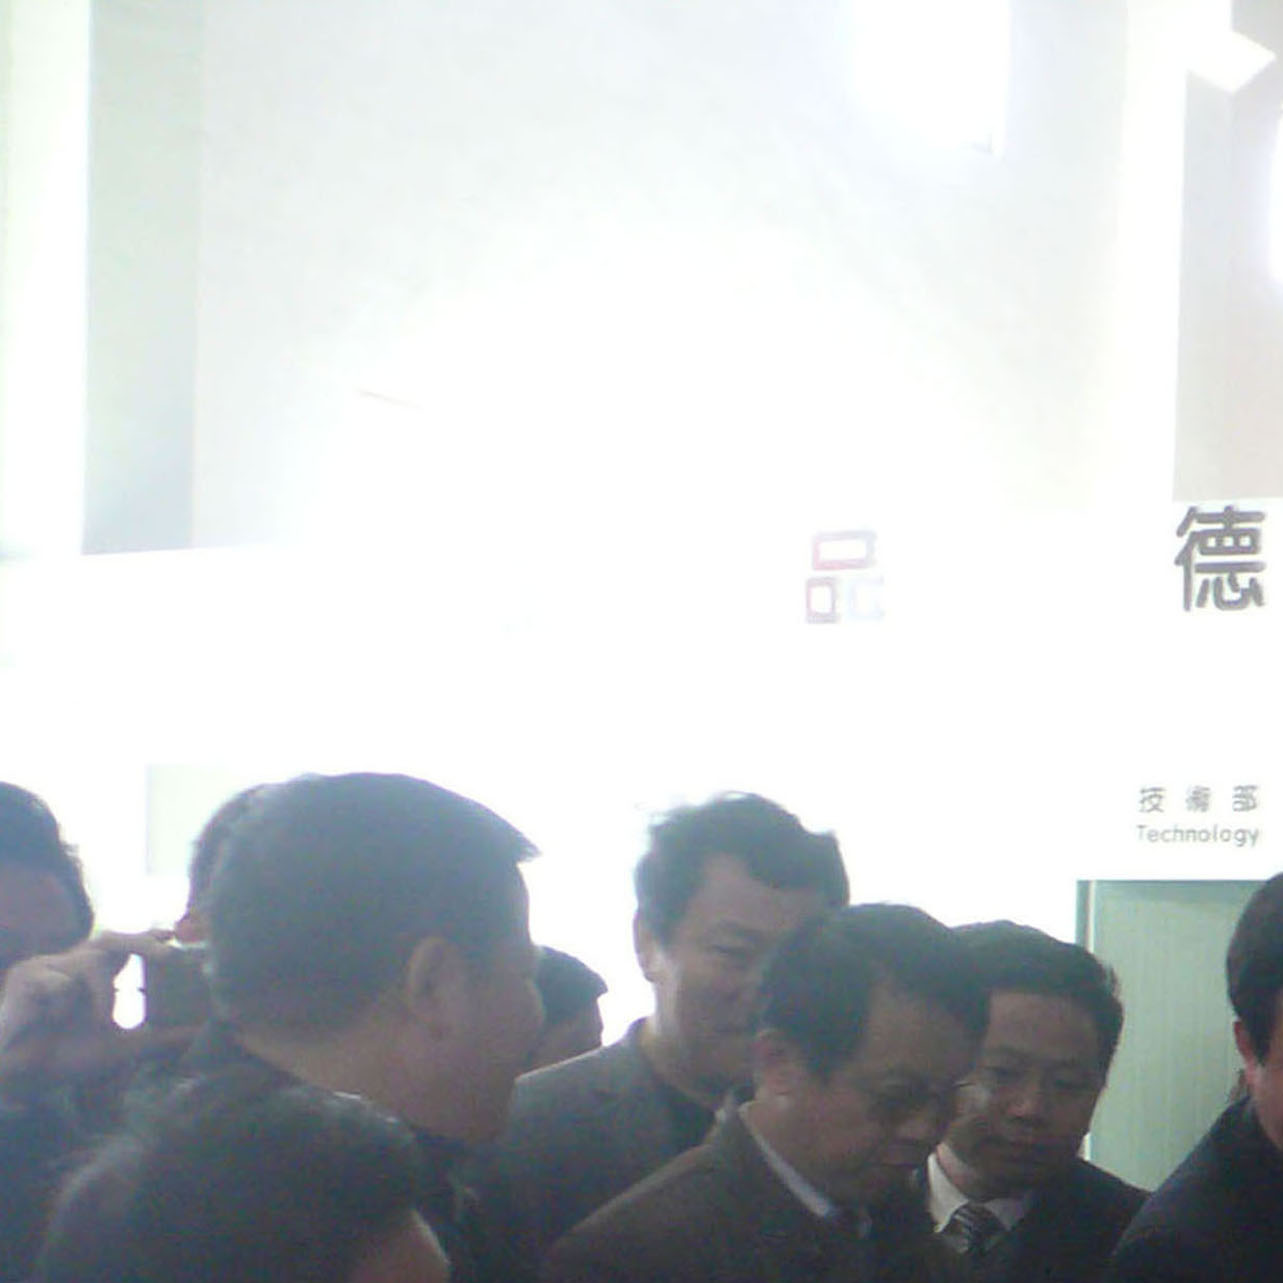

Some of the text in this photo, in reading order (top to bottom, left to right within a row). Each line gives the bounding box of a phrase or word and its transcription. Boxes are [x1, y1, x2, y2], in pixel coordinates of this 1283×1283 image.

[804, 528, 886, 625] 品
[1173, 505, 1266, 612] 德
[1135, 822, 1261, 848] Technology
